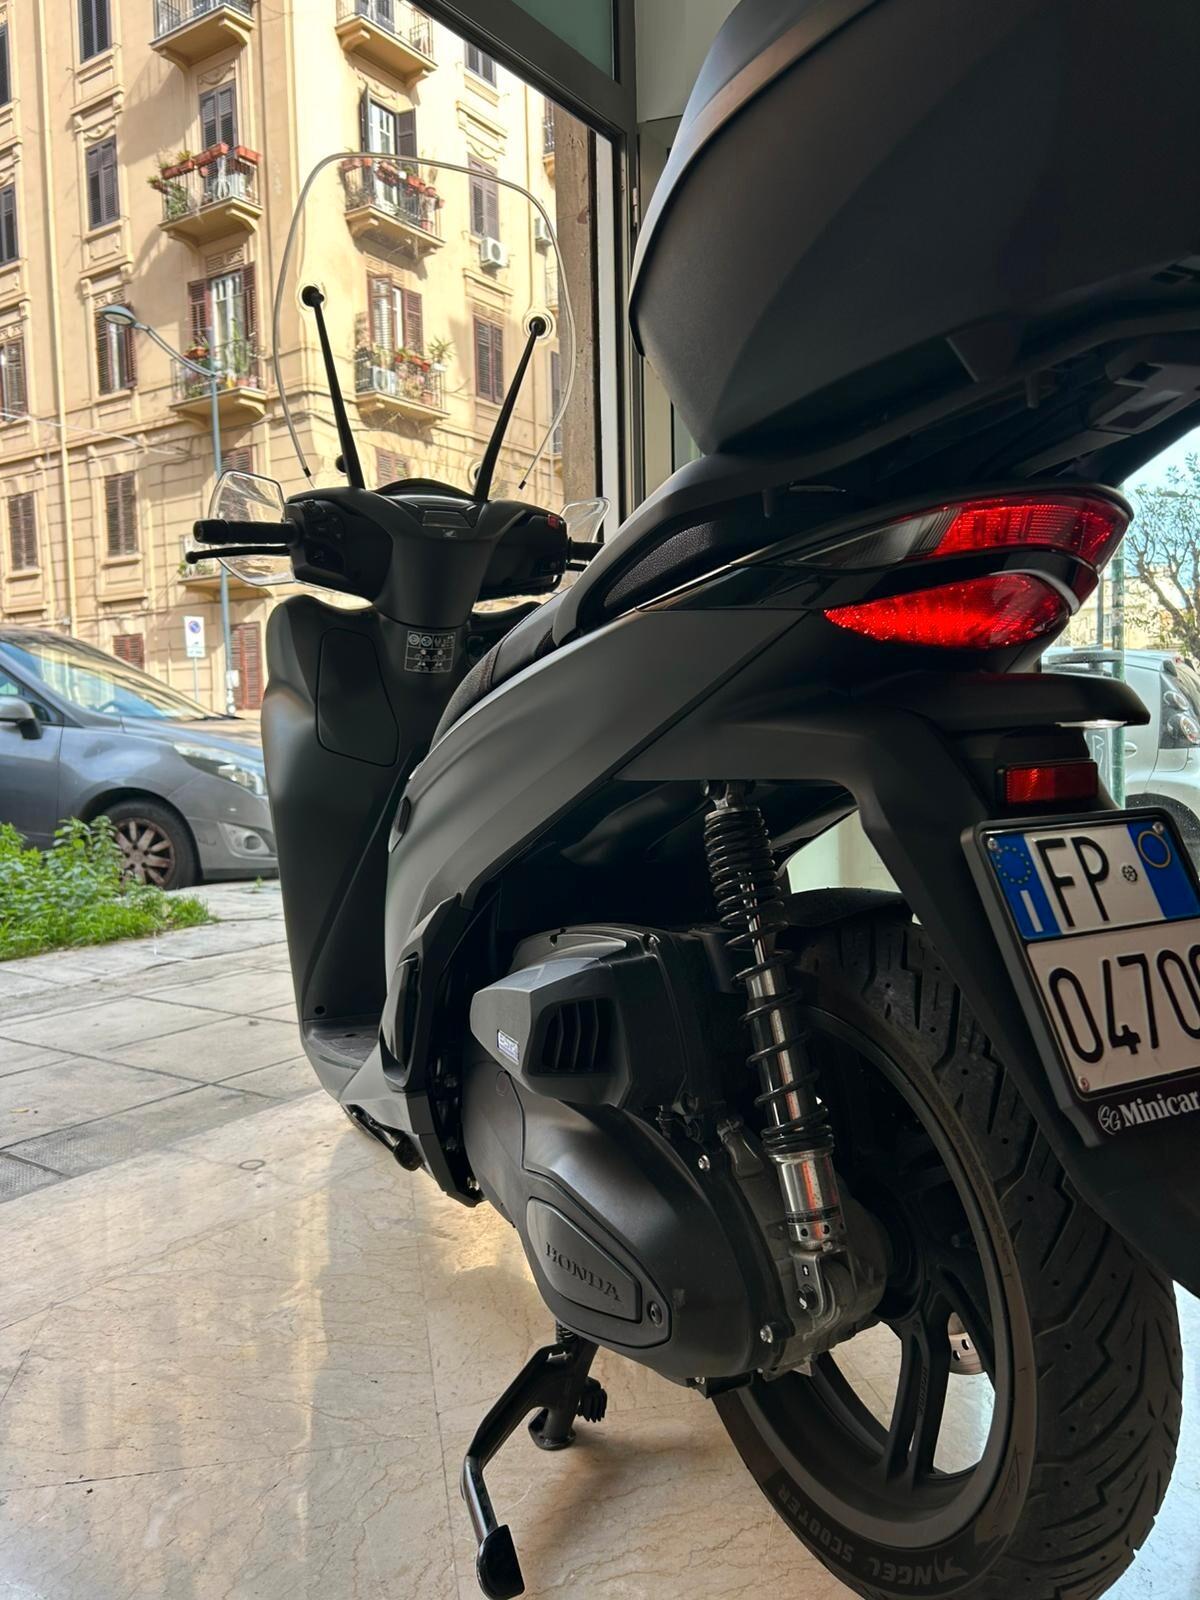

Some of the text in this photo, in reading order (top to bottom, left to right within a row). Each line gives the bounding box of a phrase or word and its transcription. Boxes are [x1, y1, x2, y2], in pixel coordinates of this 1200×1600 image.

[1034, 836, 1110, 927] FP
[1048, 944, 1200, 1064] 0470
[546, 1243, 622, 1301] HONDA
[776, 1485, 855, 1563] SCOOTER
